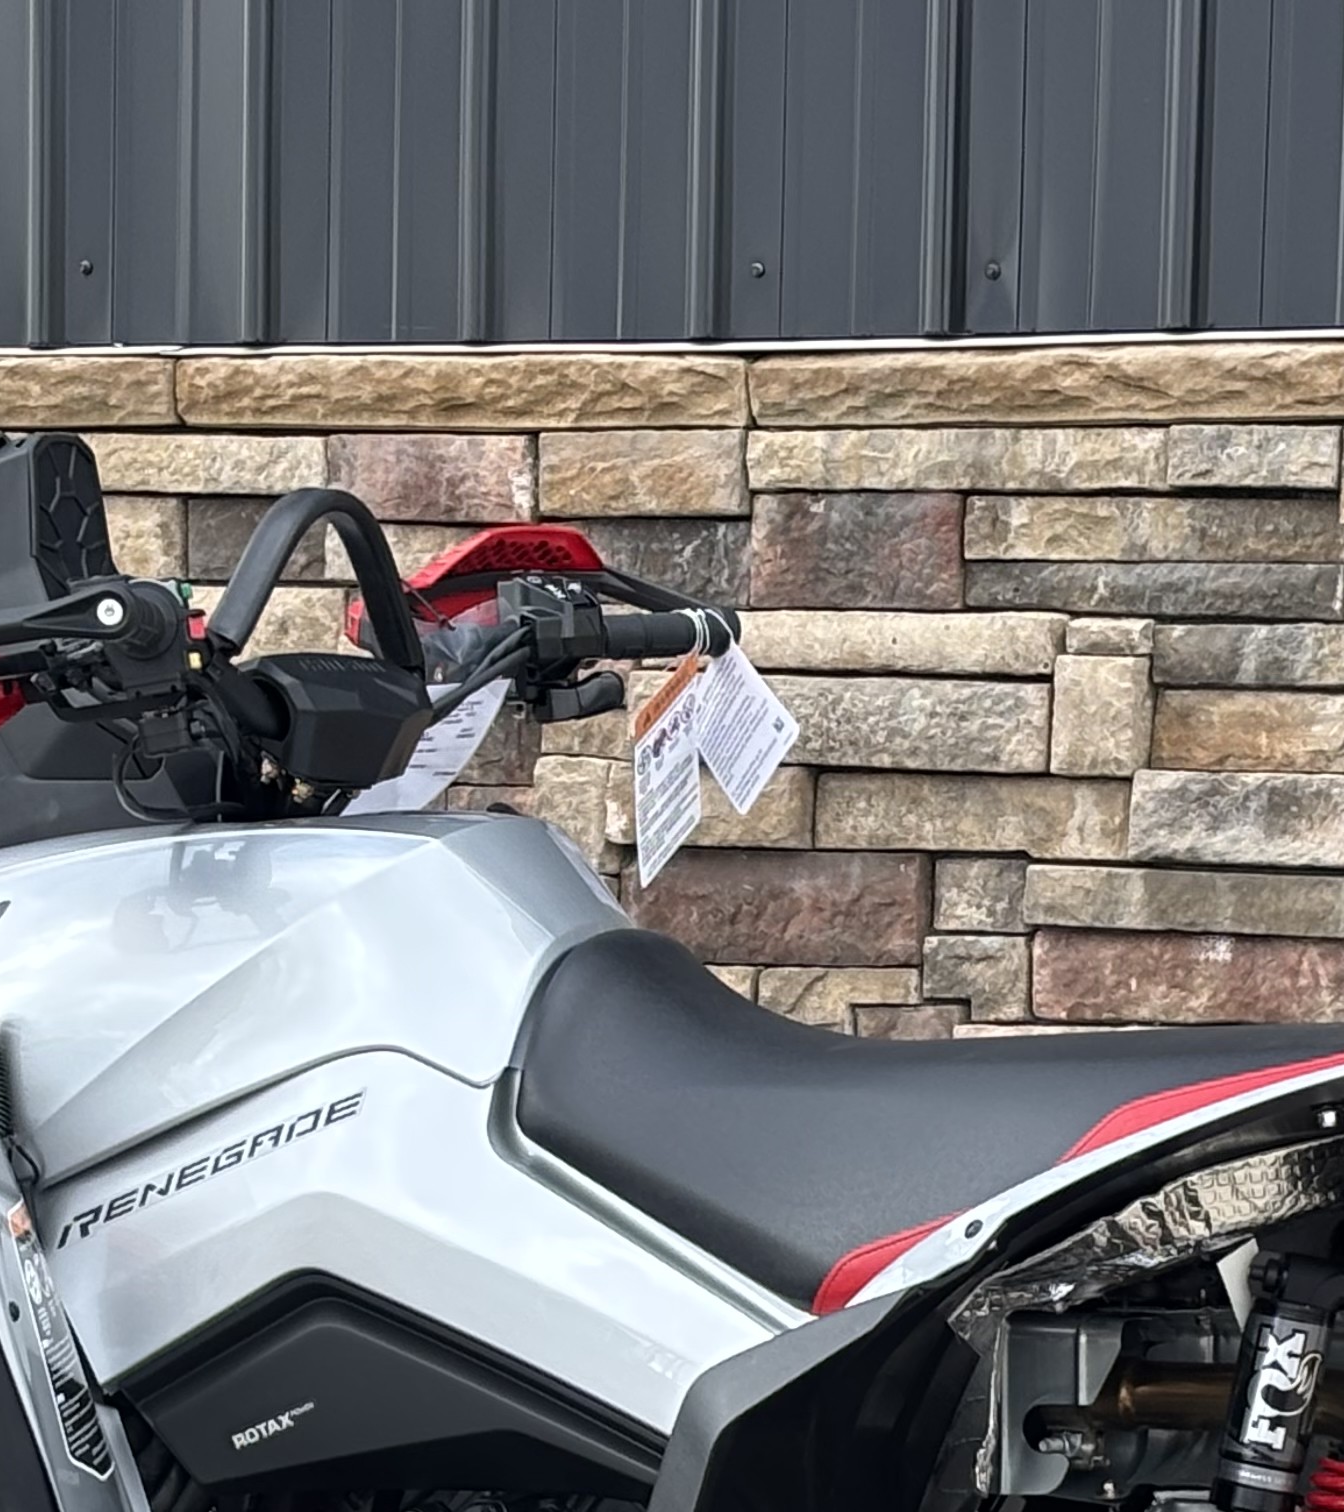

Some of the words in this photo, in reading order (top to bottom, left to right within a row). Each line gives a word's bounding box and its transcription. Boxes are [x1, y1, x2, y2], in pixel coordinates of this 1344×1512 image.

[56, 1091, 364, 1250] RENEGADE
[231, 1411, 294, 1450] ROTAX
[1239, 1324, 1323, 1451] FOX
